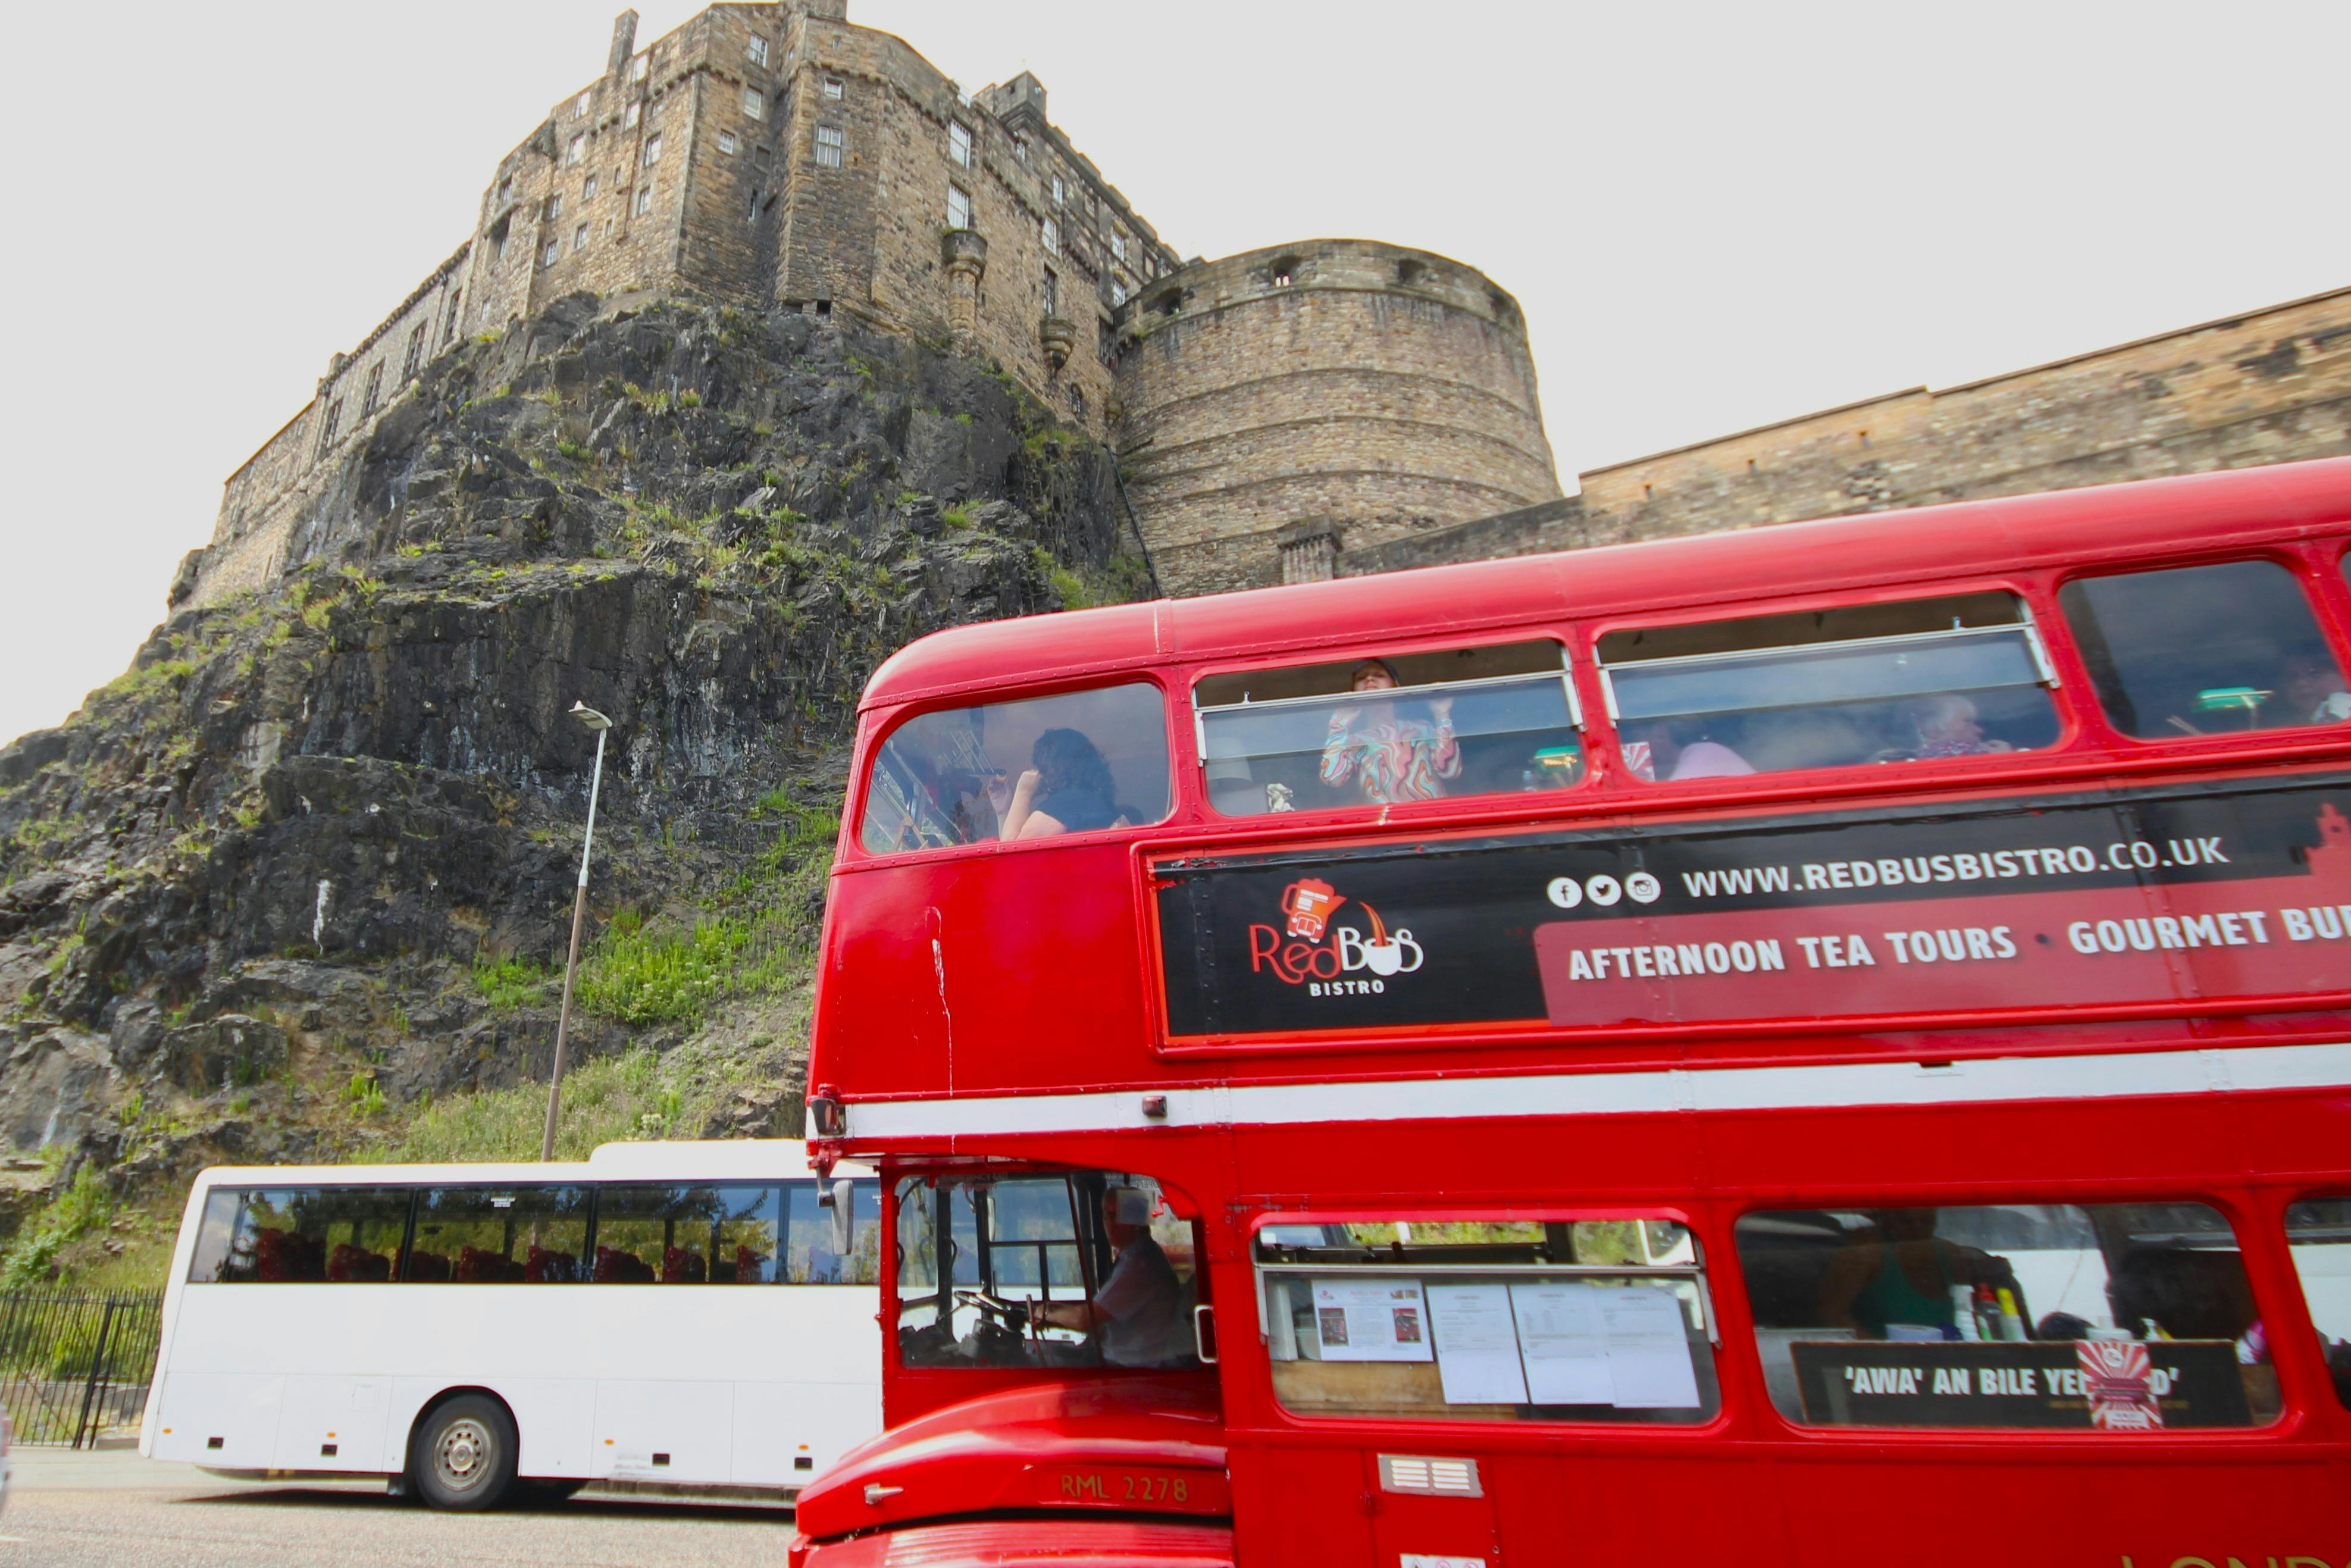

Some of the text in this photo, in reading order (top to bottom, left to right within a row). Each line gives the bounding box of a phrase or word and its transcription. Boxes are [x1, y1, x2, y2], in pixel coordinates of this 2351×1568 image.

[1682, 837, 2230, 897] WWW.REDBUSBISTRO.CO.UK
[1569, 939, 1785, 981] AFTERNOON
[1796, 934, 1876, 968] TEA
[1883, 925, 2017, 964] TOURS
[2067, 910, 2269, 954] GOURMET
[1310, 979, 1385, 997] BISTRO
[1933, 1368, 1971, 1395] AN
[1979, 1368, 2037, 1395] BILE
[1062, 1474, 1188, 1502] RML 2278
